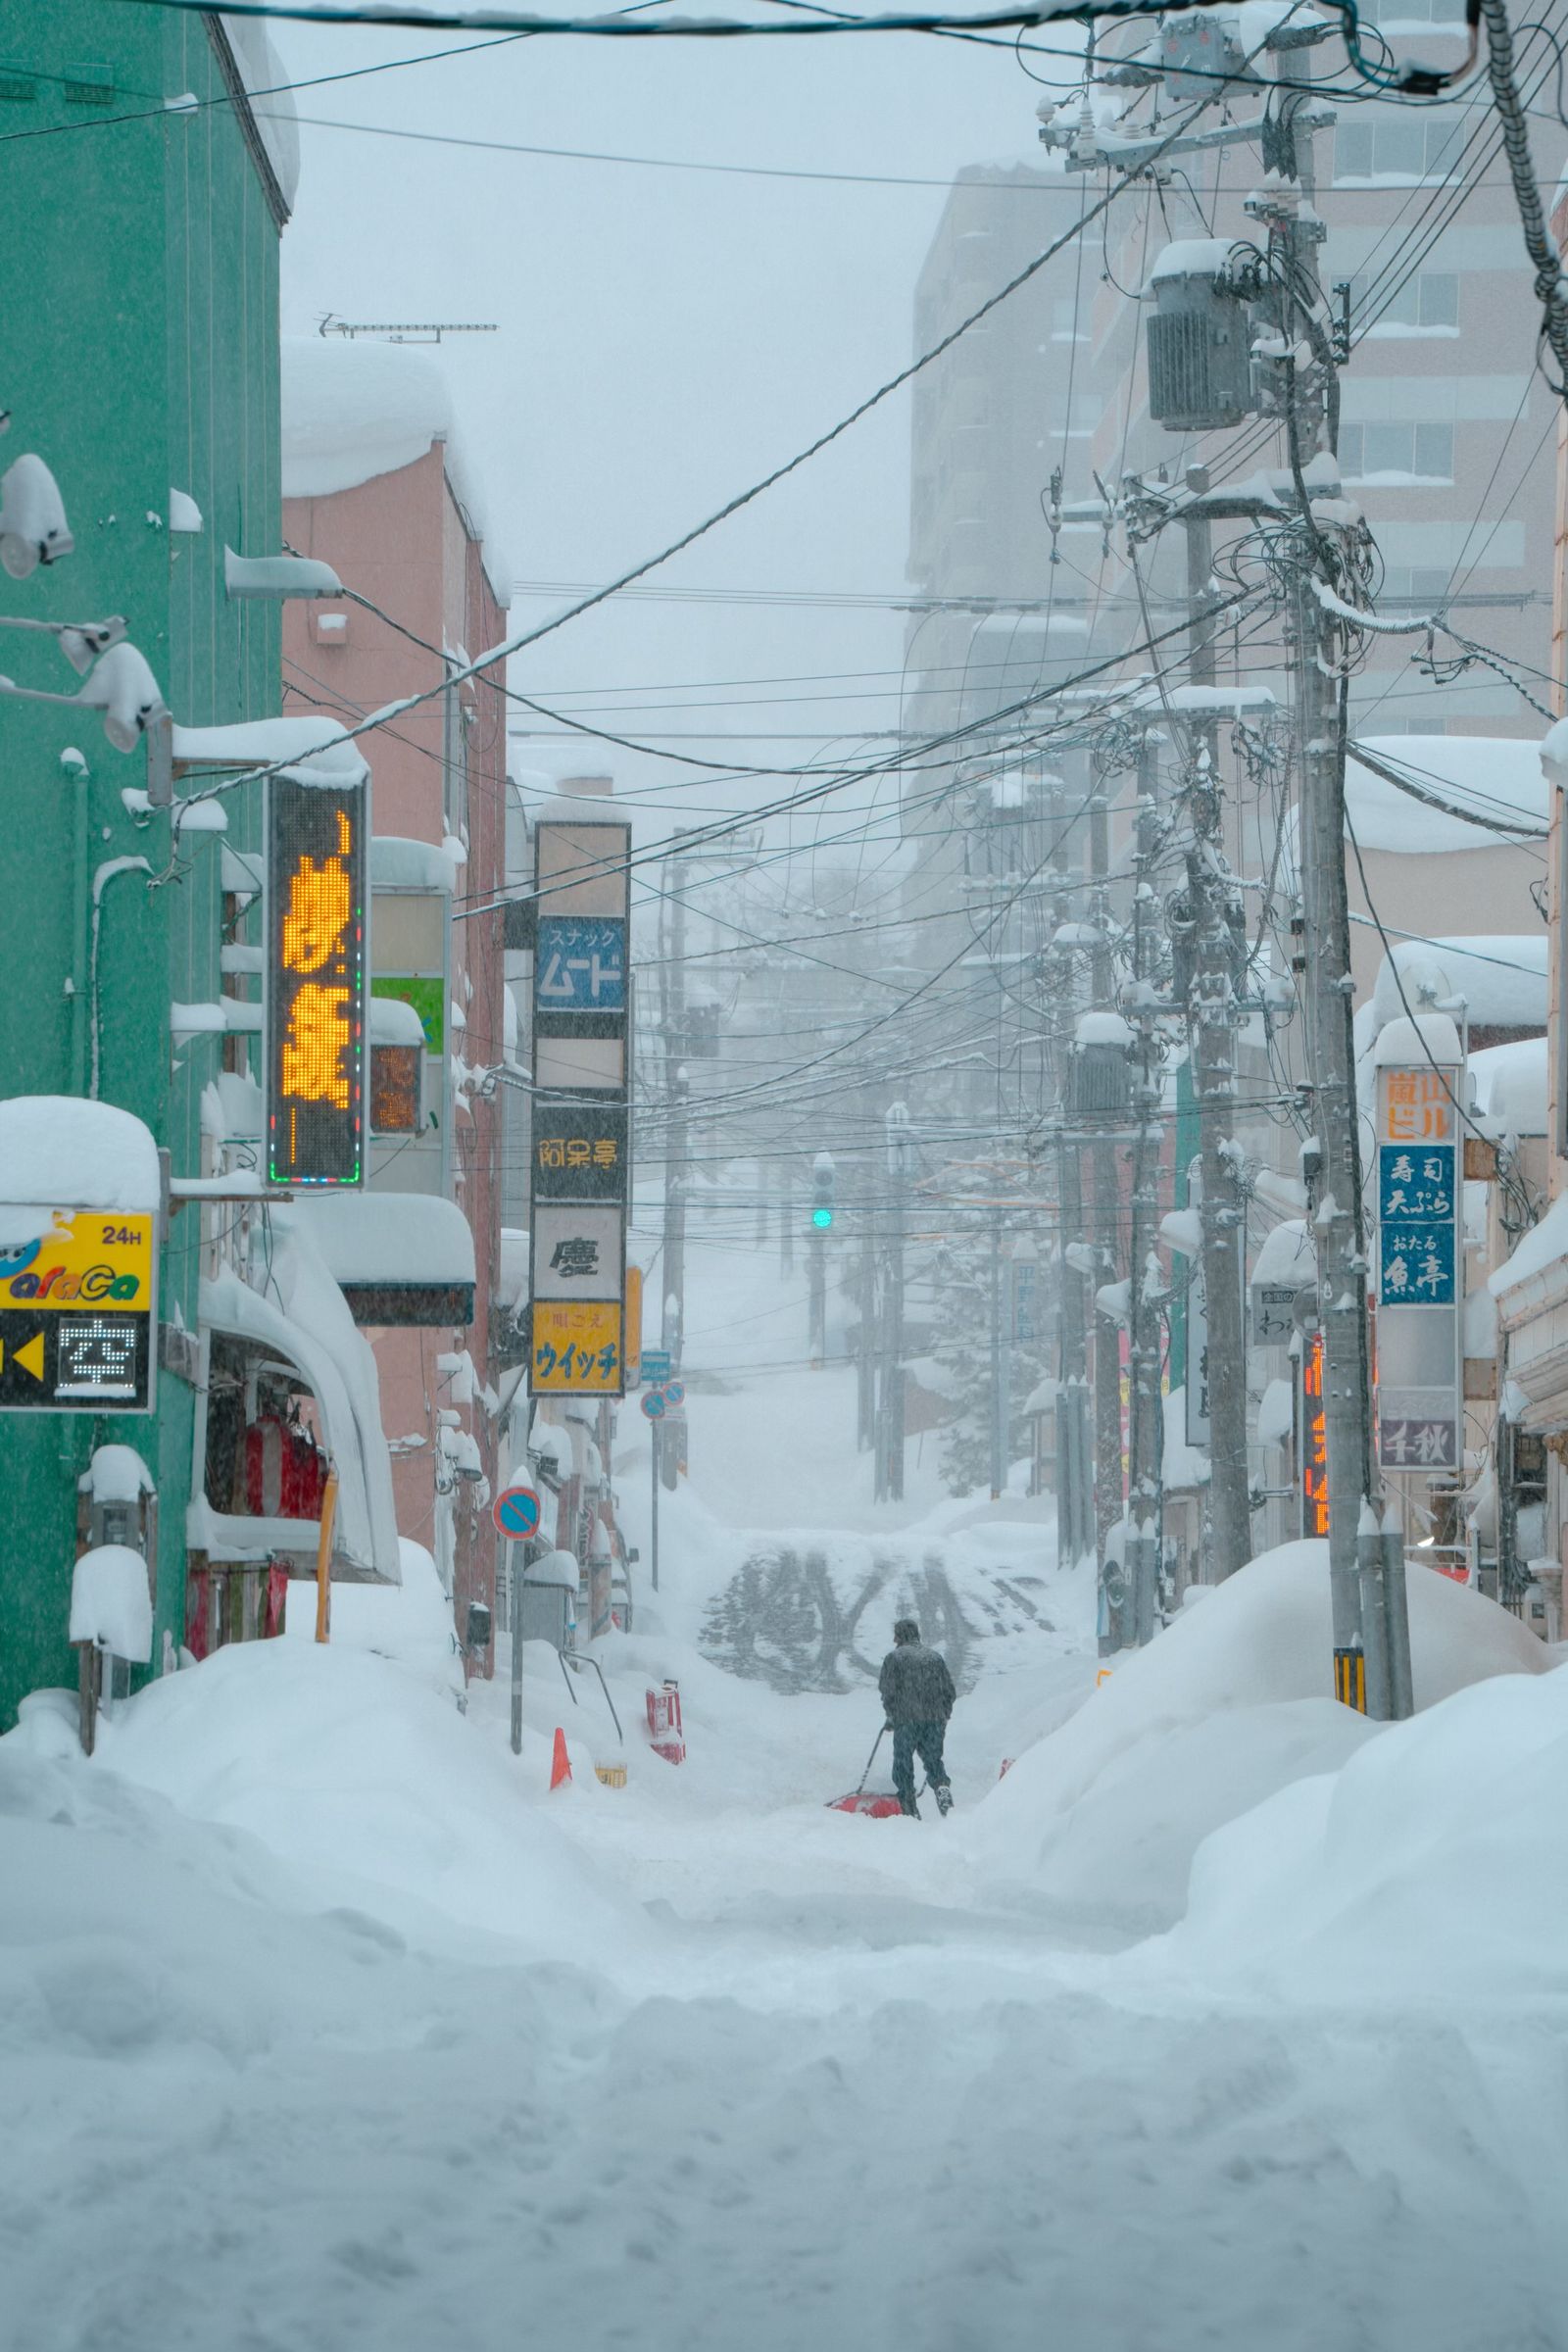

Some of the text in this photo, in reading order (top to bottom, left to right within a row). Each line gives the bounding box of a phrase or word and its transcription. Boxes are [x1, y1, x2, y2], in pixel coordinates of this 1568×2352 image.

[550, 928, 614, 947] スナック
[539, 953, 621, 998] ムード
[1388, 1073, 1450, 1104] 嵐山
[1388, 1107, 1449, 1140] ビル
[538, 1138, 618, 1170] 阿呆亭
[1391, 1154, 1444, 1183] 寿司
[1385, 1189, 1450, 1215] 天ぷら
[101, 1226, 142, 1245] 24H
[1393, 1235, 1438, 1251] おたる
[549, 1237, 601, 1278] 慶
[1384, 1255, 1449, 1297] 魚亭
[60, 1319, 135, 1388] 空
[536, 1342, 618, 1381] ウイッチ
[1385, 1421, 1448, 1463] 千秋
